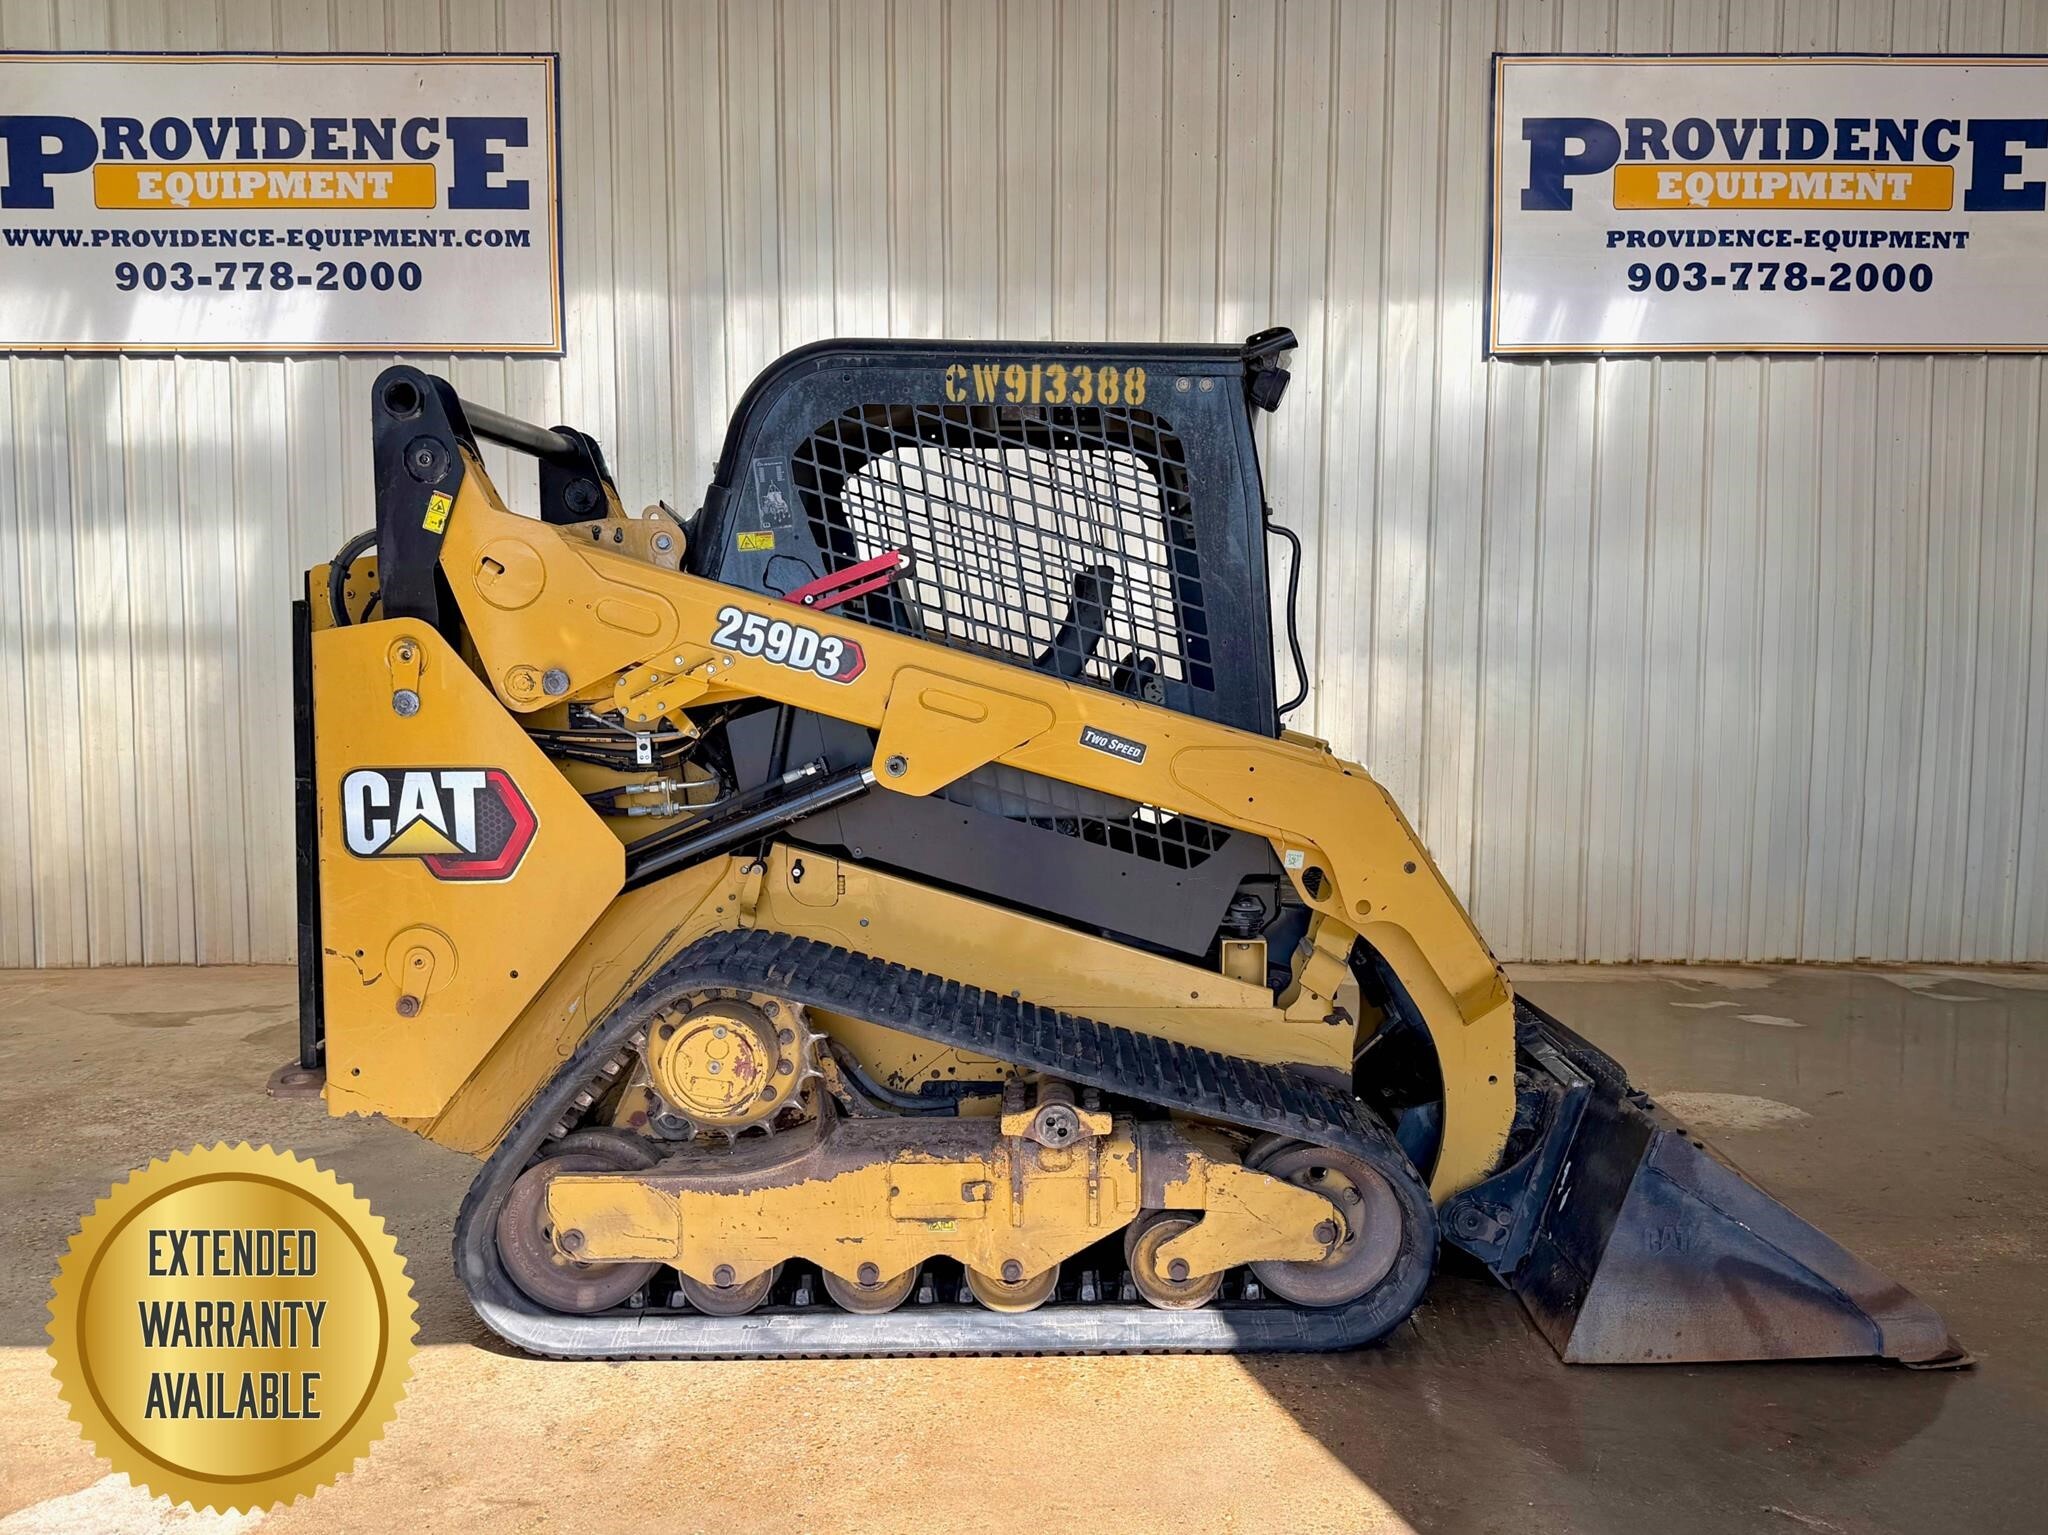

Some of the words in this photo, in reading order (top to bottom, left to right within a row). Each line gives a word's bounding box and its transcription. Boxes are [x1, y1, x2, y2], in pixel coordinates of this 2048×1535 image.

[0, 115, 530, 210] PROVIDENCE
[1521, 117, 2048, 211] PROVIDENCE
[137, 171, 393, 207] EQUIPMENT
[1656, 171, 1912, 207] EQUIPMENT
[2, 228, 531, 252] WWW.PROVIDENCE-EQUIPMENT.COM
[1606, 229, 1970, 252] PROVIDENCE-EQUIPMENT
[115, 261, 423, 292] 903-778-2000
[1627, 262, 1933, 292] 903-778-2000
[945, 363, 1146, 405] CW913388
[712, 606, 845, 677] 259D3
[344, 770, 487, 855] CAT
